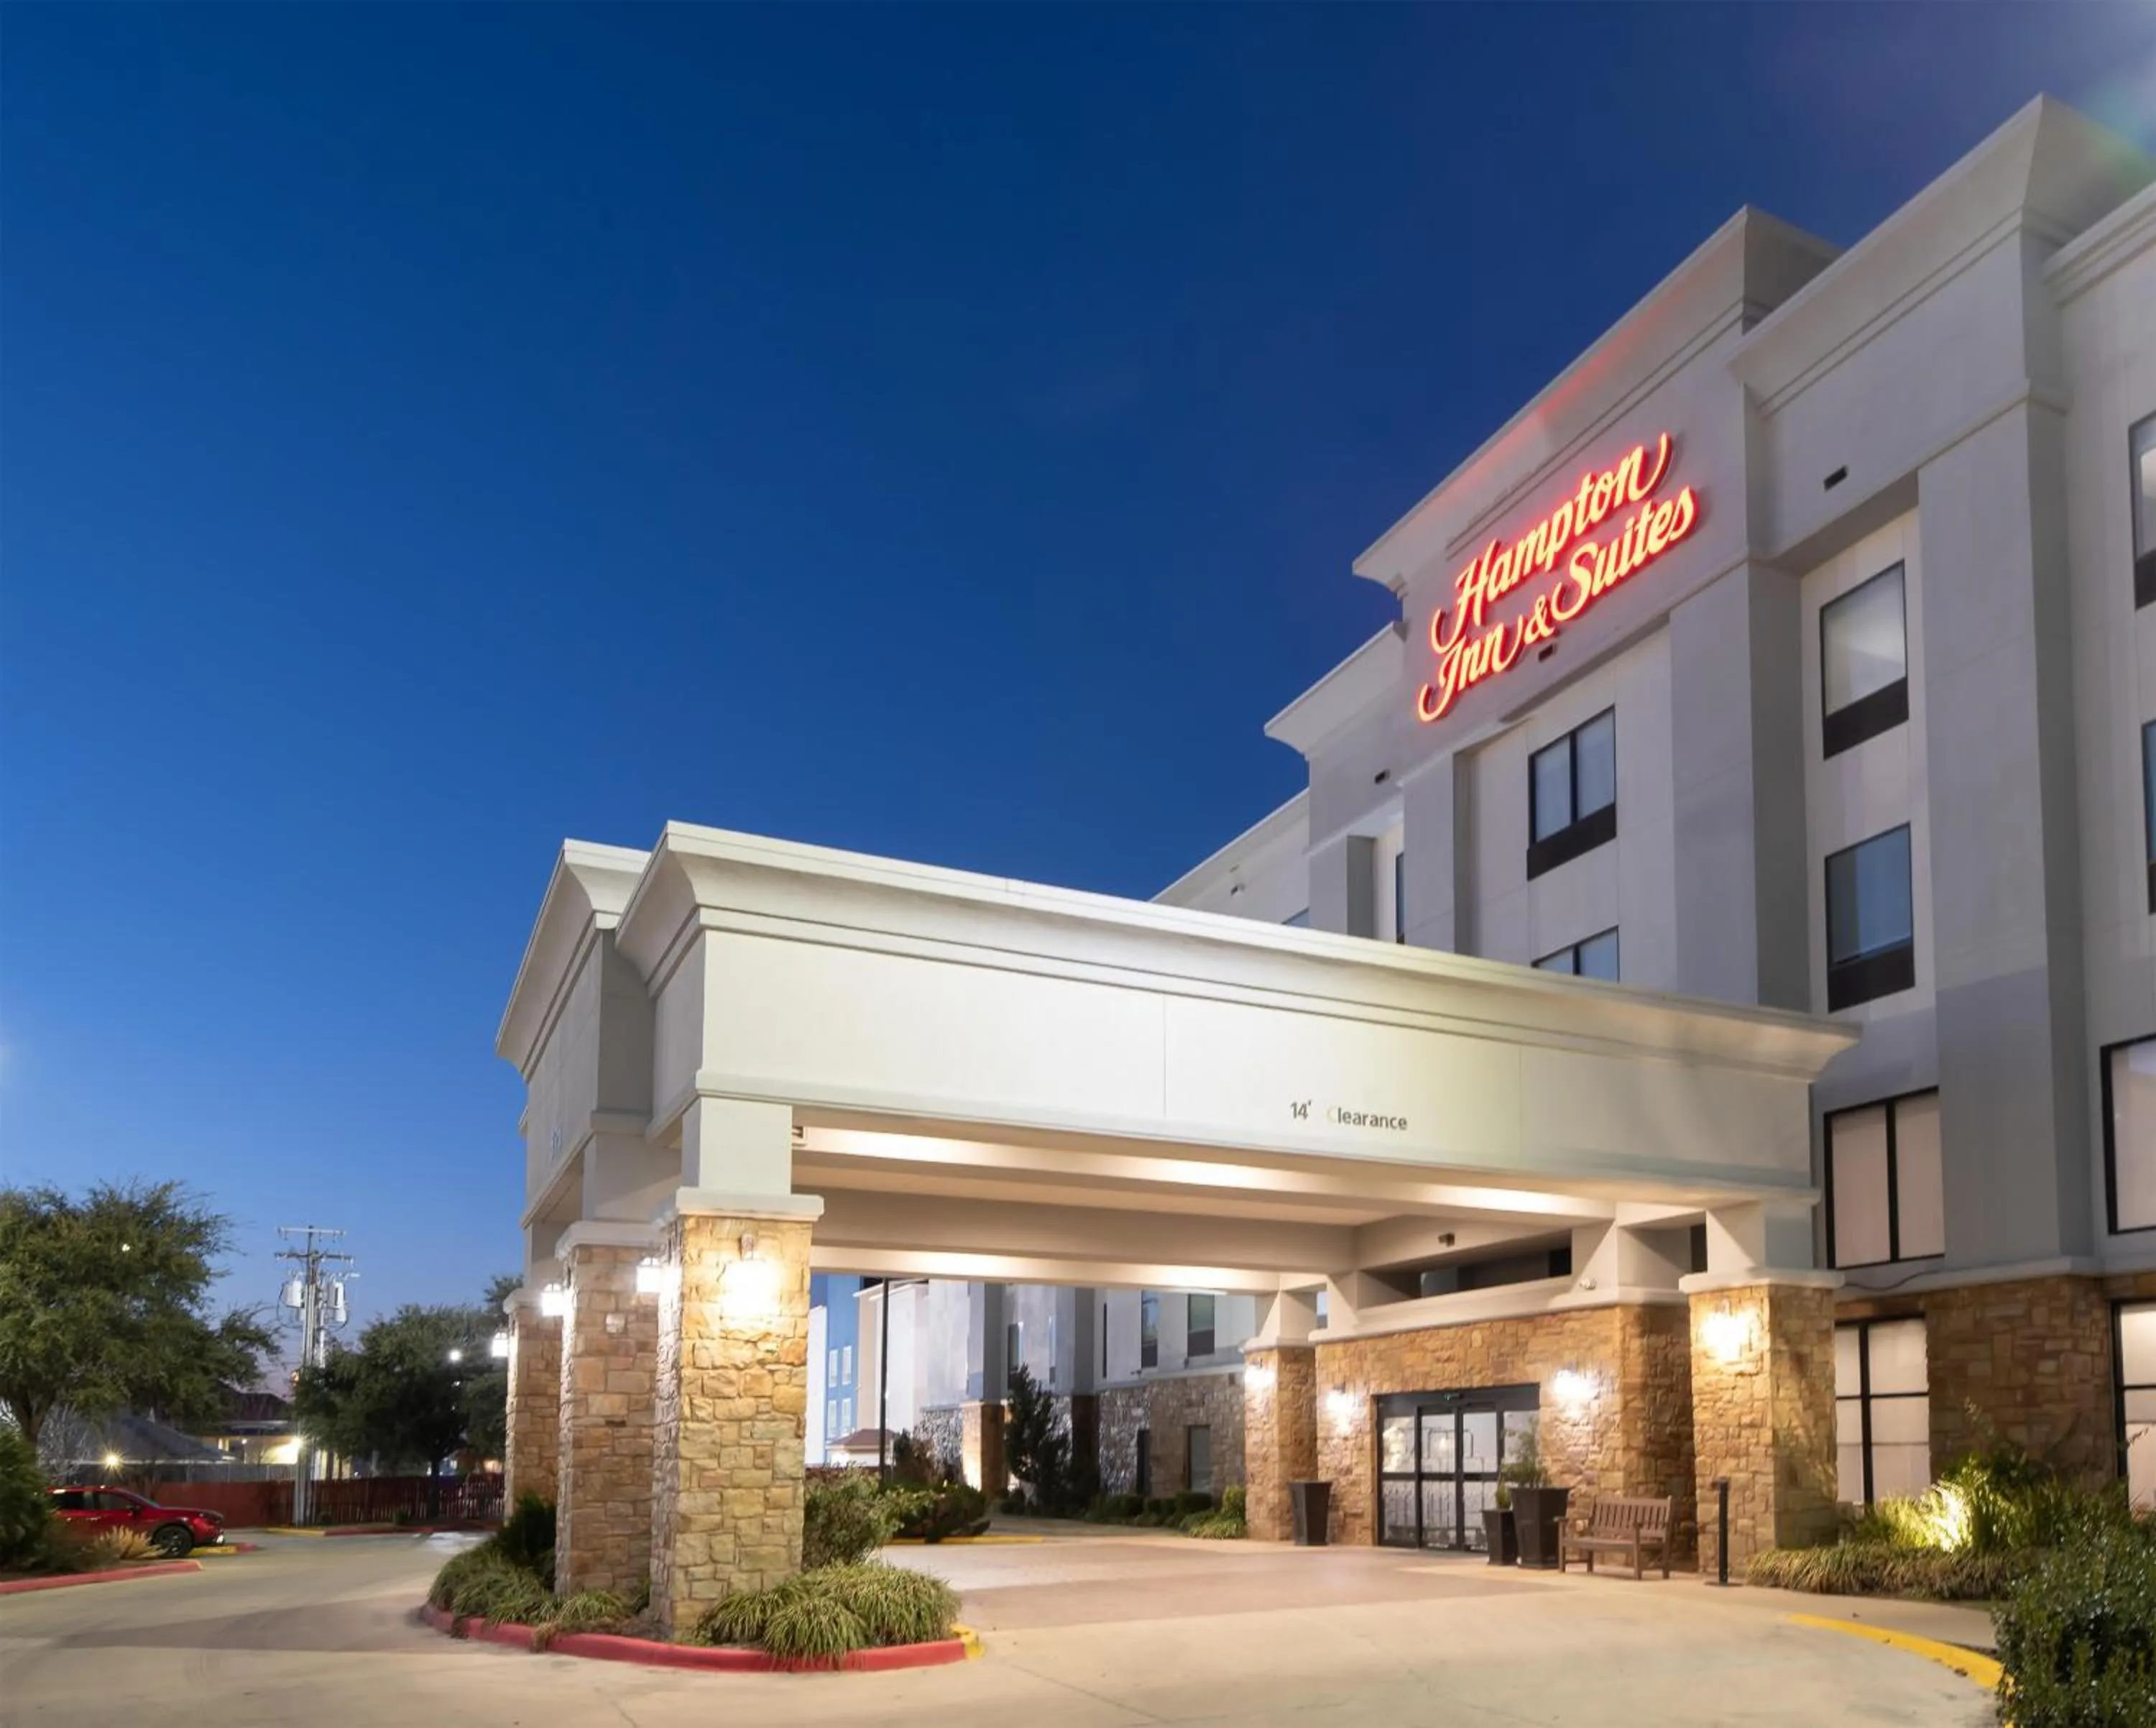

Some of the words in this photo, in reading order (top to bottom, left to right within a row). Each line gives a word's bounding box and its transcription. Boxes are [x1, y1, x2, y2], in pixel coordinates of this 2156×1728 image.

[1418, 615, 1524, 722] Inn
[1524, 594, 1557, 645] &
[1552, 484, 1699, 622] Suites
[1431, 432, 1672, 654] Hampton
